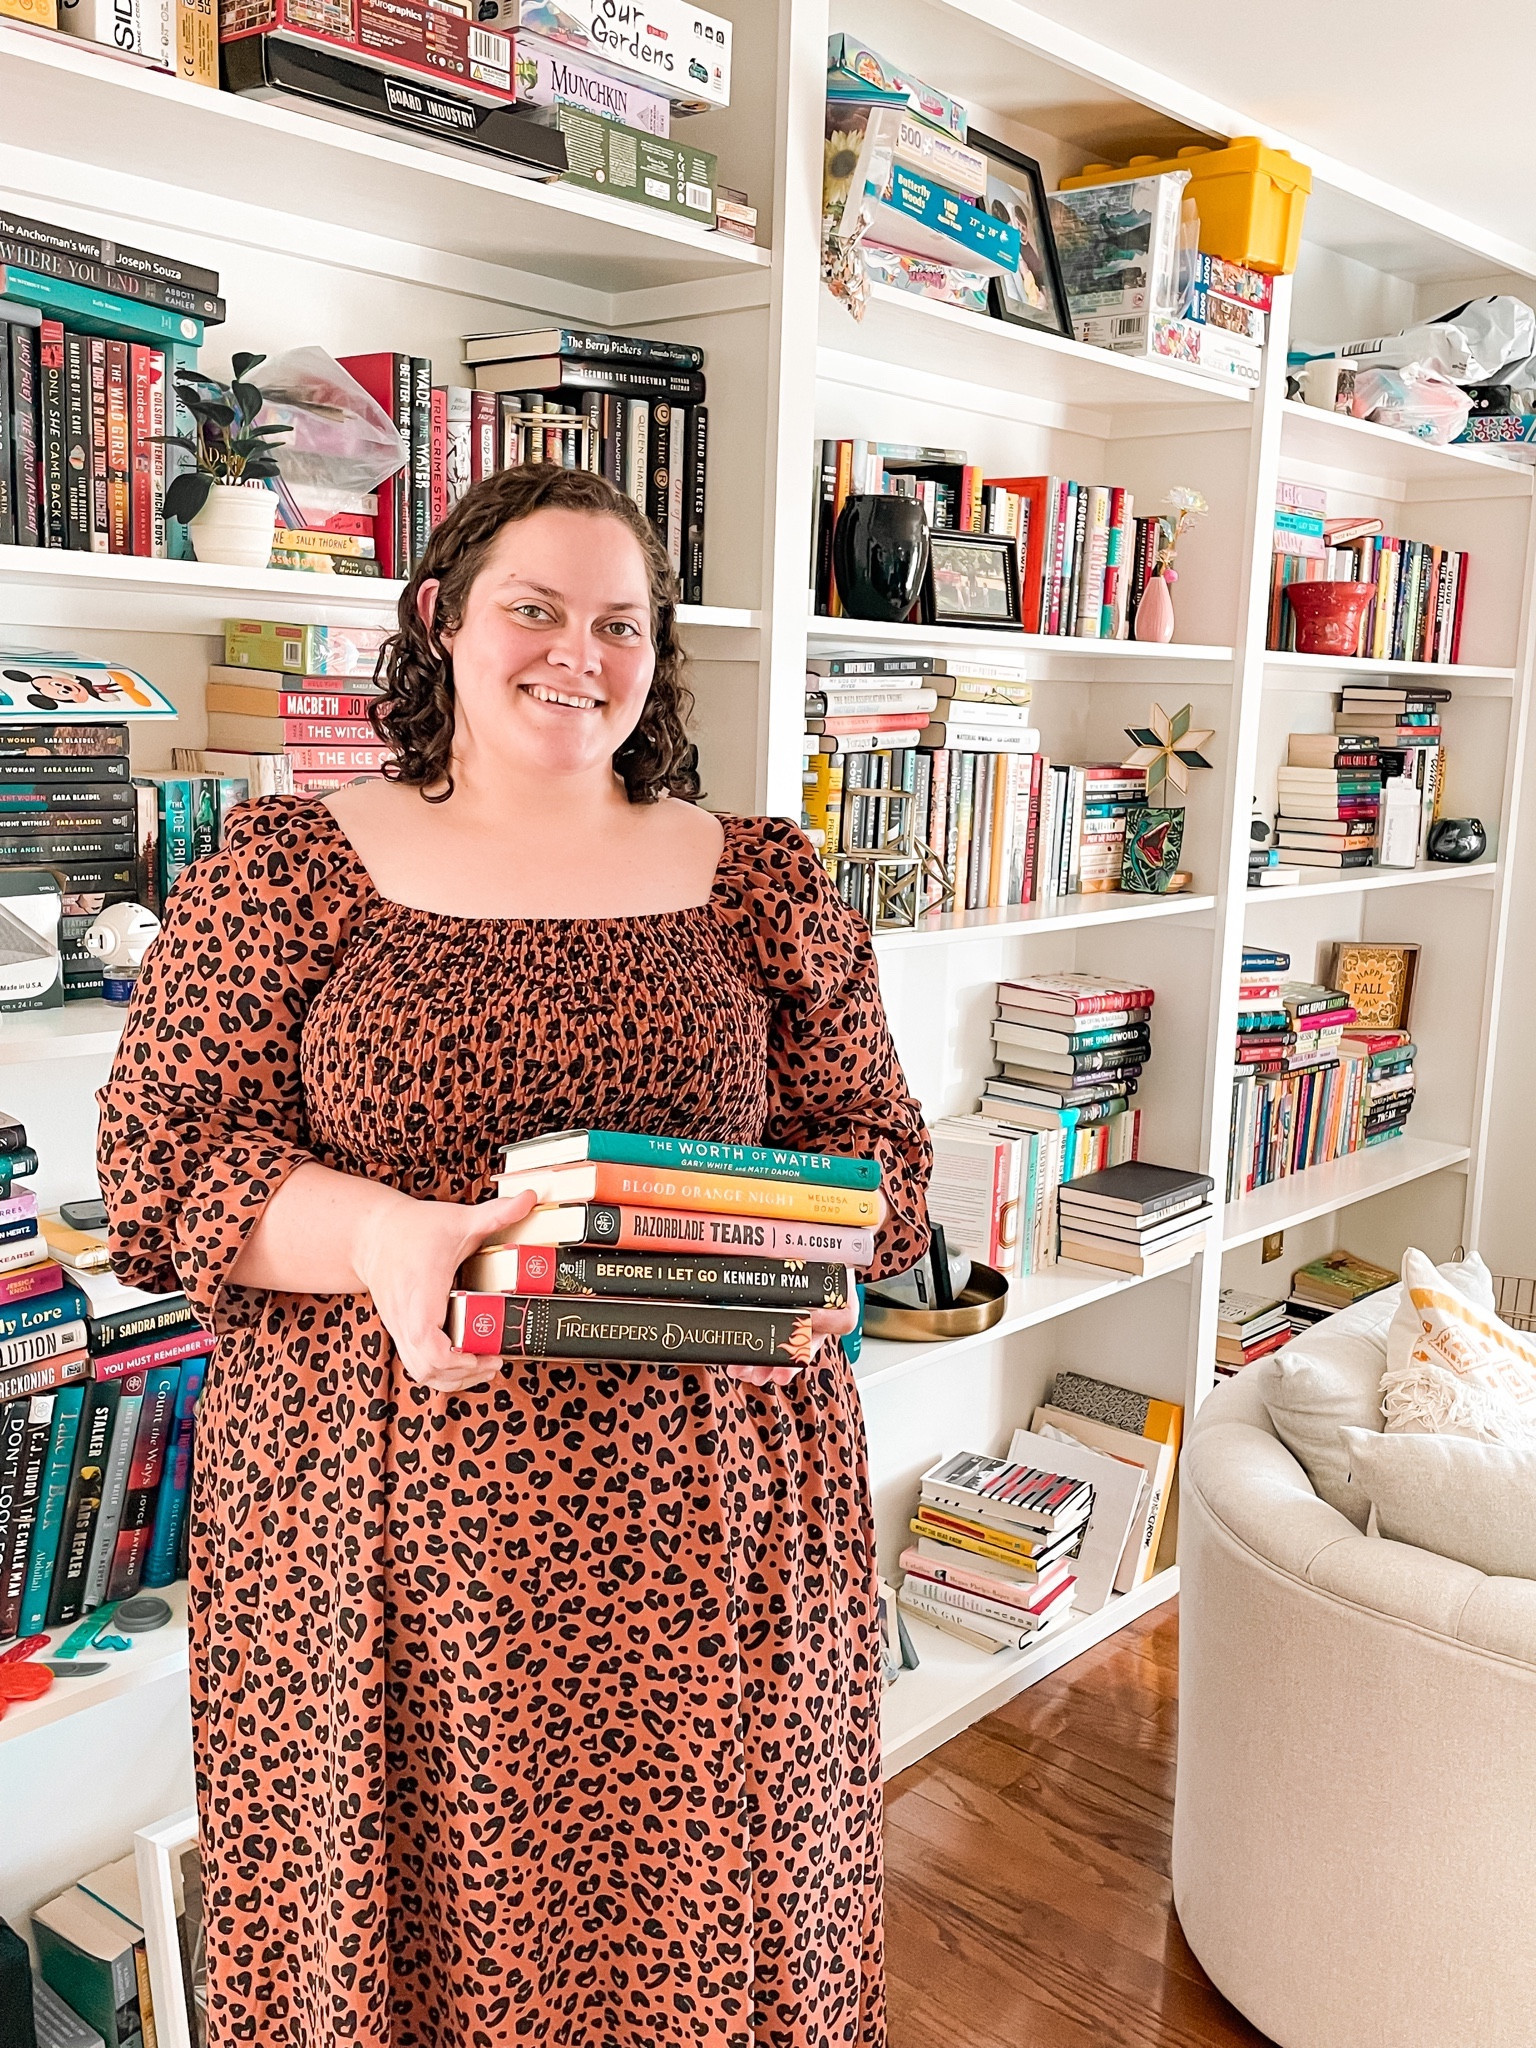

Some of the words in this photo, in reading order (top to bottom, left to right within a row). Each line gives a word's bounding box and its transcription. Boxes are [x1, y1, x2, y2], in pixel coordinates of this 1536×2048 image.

[591, 14, 675, 71] Gardens
[550, 60, 628, 116] MUNCHKIN
[388, 88, 423, 111] BOARD
[426, 100, 474, 129] INDUSTRY
[900, 123, 922, 149] 500
[898, 173, 931, 201] Butterfly
[901, 187, 926, 210] Woods
[15, 224, 78, 250] Anchorman's
[78, 242, 100, 257] Wife
[115, 253, 151, 272] Joseph
[153, 264, 182, 280] Souza
[67, 259, 101, 284] YOU
[106, 271, 140, 294] END
[164, 287, 196, 301] ABBOTT
[164, 298, 196, 311] KAHLER
[16, 335, 31, 367] LUCY
[567, 335, 583, 349] The
[585, 338, 610, 355] Berry
[611, 342, 642, 356] Pickers
[69, 342, 81, 380] MAIDENS
[110, 363, 122, 383] THE
[1235, 364, 1260, 382] 1000
[19, 368, 33, 404] FOLEY
[48, 368, 60, 406] ONLY
[69, 382, 81, 392] OF
[92, 365, 105, 391] DAY
[415, 368, 431, 409] WADE
[70, 394, 82, 412] THE
[110, 387, 124, 422] WILD
[135, 373, 149, 425] Kindest
[19, 410, 34, 439] THE
[49, 409, 61, 438] SHE
[71, 413, 82, 435] CAVE
[433, 398, 442, 433] TRUE
[111, 425, 125, 466] GIRLS
[637, 414, 646, 454] QUEEN
[697, 416, 706, 458] BEHIND
[21, 435, 36, 474] PARIS
[49, 441, 61, 480] CAME
[415, 442, 431, 490] WATER
[433, 438, 442, 482] CRIME
[25, 473, 38, 536] APARTMENT
[50, 482, 62, 518] BACK
[114, 471, 124, 508] PHOEBE
[695, 487, 704, 514] EYES
[114, 509, 124, 547] MORGAN
[416, 500, 424, 559] NKRUMAH
[1075, 491, 1088, 543] SPOOKED
[154, 524, 163, 546] BOYS
[296, 534, 316, 546] SALLY
[318, 538, 347, 549] THORNE
[1020, 537, 1028, 573] TOWN
[1440, 561, 1448, 580] THE
[287, 695, 340, 716] MACBETH
[347, 698, 361, 716] JO
[307, 725, 333, 738] THE
[317, 751, 346, 765] THE
[350, 751, 374, 765] ICE
[950, 767, 958, 814] Wilkerson
[75, 818, 102, 826] BLAEDEL
[172, 810, 185, 833] ICE
[72, 844, 102, 852] BLAEDEL
[946, 826, 959, 886] Caste
[1353, 982, 1384, 995] FALL
[1356, 967, 1386, 981] HAPPY
[1298, 1004, 1310, 1016] LARS
[1310, 1000, 1327, 1014] KEPLER
[1356, 997, 1379, 1008] Y'ALL
[1082, 1036, 1094, 1045] THE
[1095, 1029, 1139, 1045] UNDERWORLD
[648, 1140, 673, 1152] THE
[677, 1142, 744, 1161] WORTH
[751, 1151, 768, 1162] OF
[772, 1150, 832, 1170] WATER
[680, 1158, 705, 1169] GARY
[706, 1161, 733, 1172] WHITE
[747, 1165, 770, 1176] MATT
[771, 1167, 800, 1178] DAMON
[622, 1179, 676, 1196] BLOOD
[681, 1184, 744, 1203] ORANGE
[749, 1191, 795, 1207] NIGHT
[807, 1193, 848, 1205] MELISSA
[813, 1204, 841, 1215] BOND
[7, 1226, 31, 1237] HERTZ
[633, 1215, 705, 1241] RAZORBLADE
[710, 1221, 765, 1247] TEARS
[809, 1235, 843, 1250] COSBY
[6, 1277, 35, 1290] JESSICA
[9, 1284, 33, 1296] KNOLL
[596, 1263, 654, 1279] BEFORE
[657, 1266, 663, 1280] I
[667, 1266, 694, 1281] LET
[696, 1268, 718, 1283] GO
[723, 1270, 777, 1287] KENNEDY
[780, 1273, 810, 1289] RYAN
[21, 1306, 63, 1328] Lore
[119, 1317, 156, 1338] SANDRA
[157, 1308, 192, 1328] BROWN
[524, 1309, 534, 1345] BOULLEY
[555, 1316, 658, 1342] FIREKEEPER'S
[661, 1321, 764, 1351] DAUGHTER
[103, 1362, 125, 1375] YOU
[126, 1355, 152, 1370] MUST
[153, 1342, 201, 1362] REMEMBER
[152, 1379, 171, 1424] Count
[55, 1407, 79, 1455] Take
[88, 1406, 109, 1458] STALKER
[4, 1418, 25, 1478] DON'T
[23, 1458, 42, 1498] TUDOR
[142, 1446, 159, 1486] Ways
[76, 1497, 91, 1529] LARS
[135, 1494, 148, 1526] JOYCE
[927, 1528, 936, 1537] THE
[11, 1531, 30, 1570] CHALK
[67, 1531, 88, 1579] KEPLER
[7, 1569, 22, 1598] MAN
[912, 1598, 939, 1615] PAIN
[941, 1610, 963, 1624] GAP
